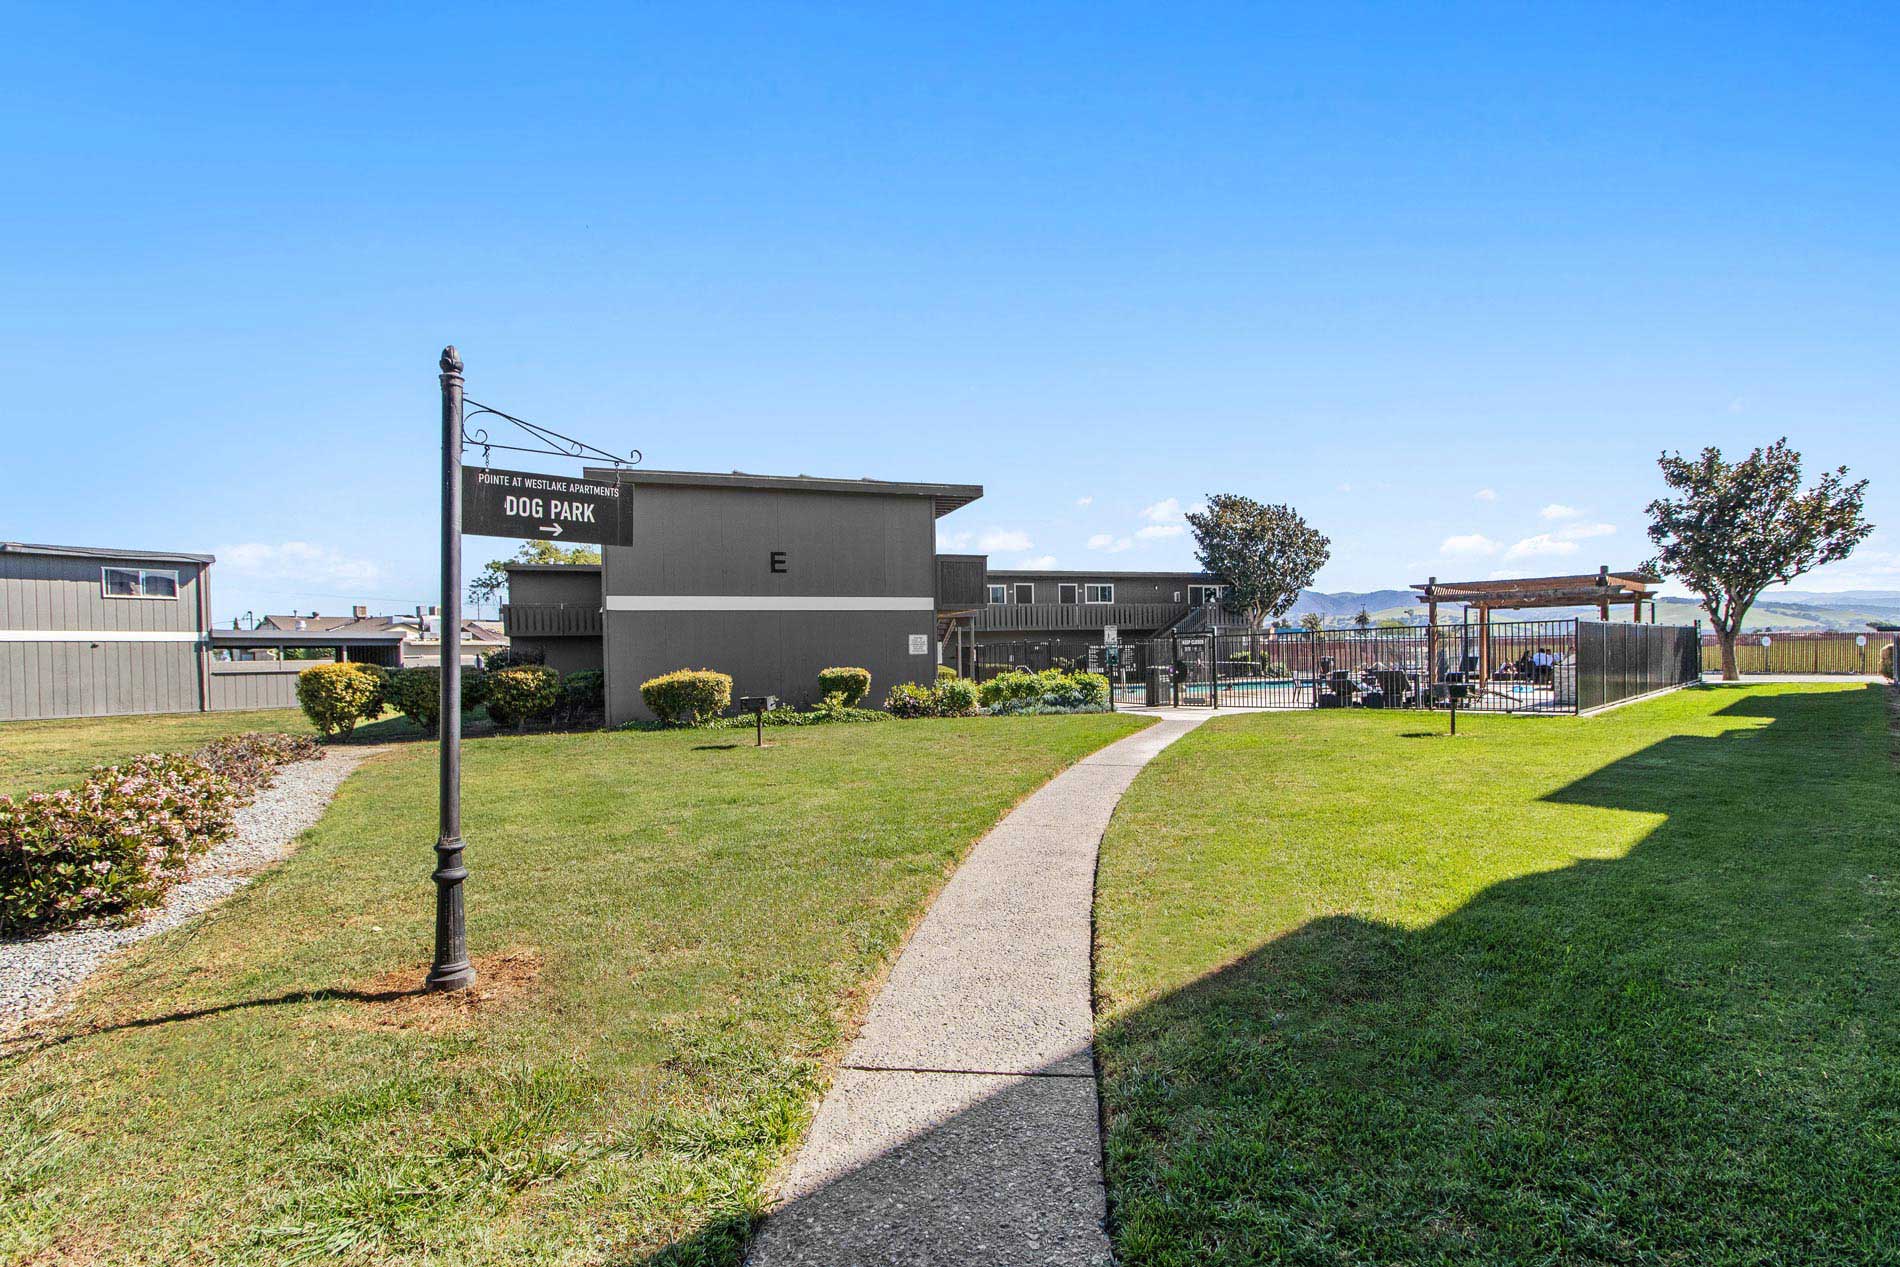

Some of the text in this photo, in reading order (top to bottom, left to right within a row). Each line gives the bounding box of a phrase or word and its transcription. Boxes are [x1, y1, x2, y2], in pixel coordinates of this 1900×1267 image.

[478, 473, 620, 498] POINTE AT WESTLAKE APARTMENTS
[505, 495, 596, 523] DOG PARK
[770, 551, 787, 573] E
